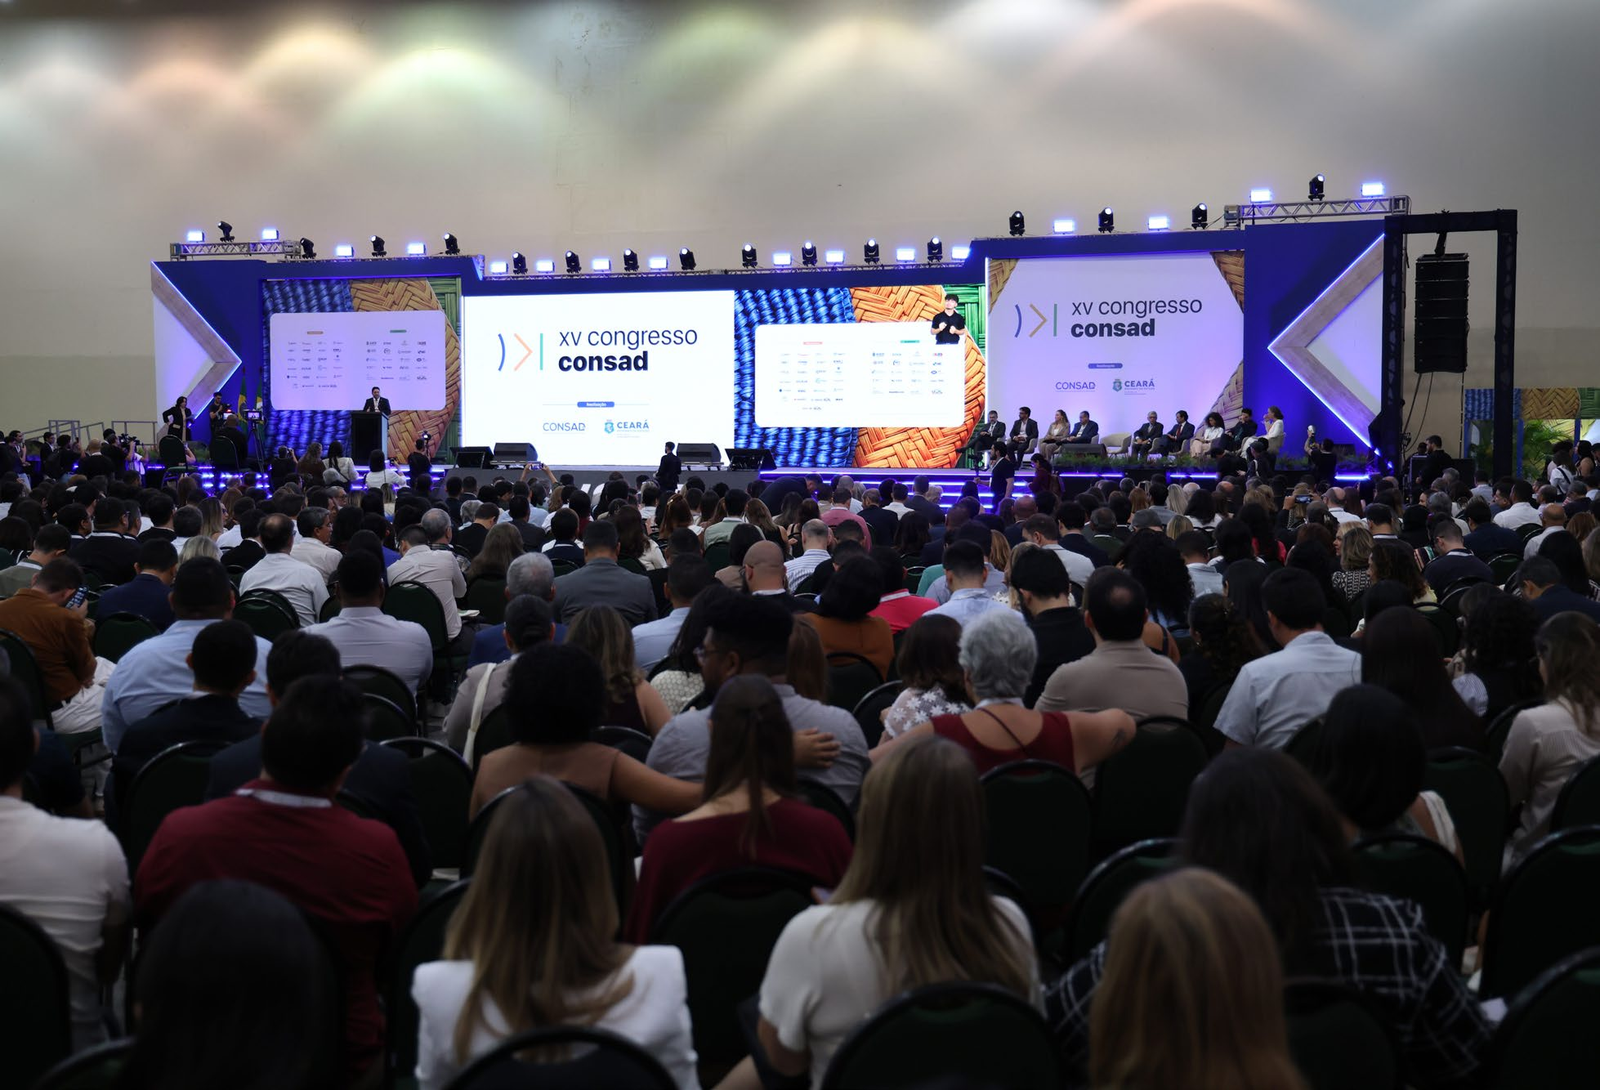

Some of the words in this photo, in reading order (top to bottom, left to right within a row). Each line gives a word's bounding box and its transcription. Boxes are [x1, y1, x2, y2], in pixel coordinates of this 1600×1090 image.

[1098, 298, 1203, 319] congresso
[1070, 318, 1156, 338] consad
[587, 328, 698, 351] congresso
[558, 351, 649, 372] consad
[1055, 381, 1096, 390] CONSAD
[1124, 378, 1155, 388] CEARÁ
[542, 422, 586, 432] CONSAD
[616, 419, 650, 429] CEARÁ
